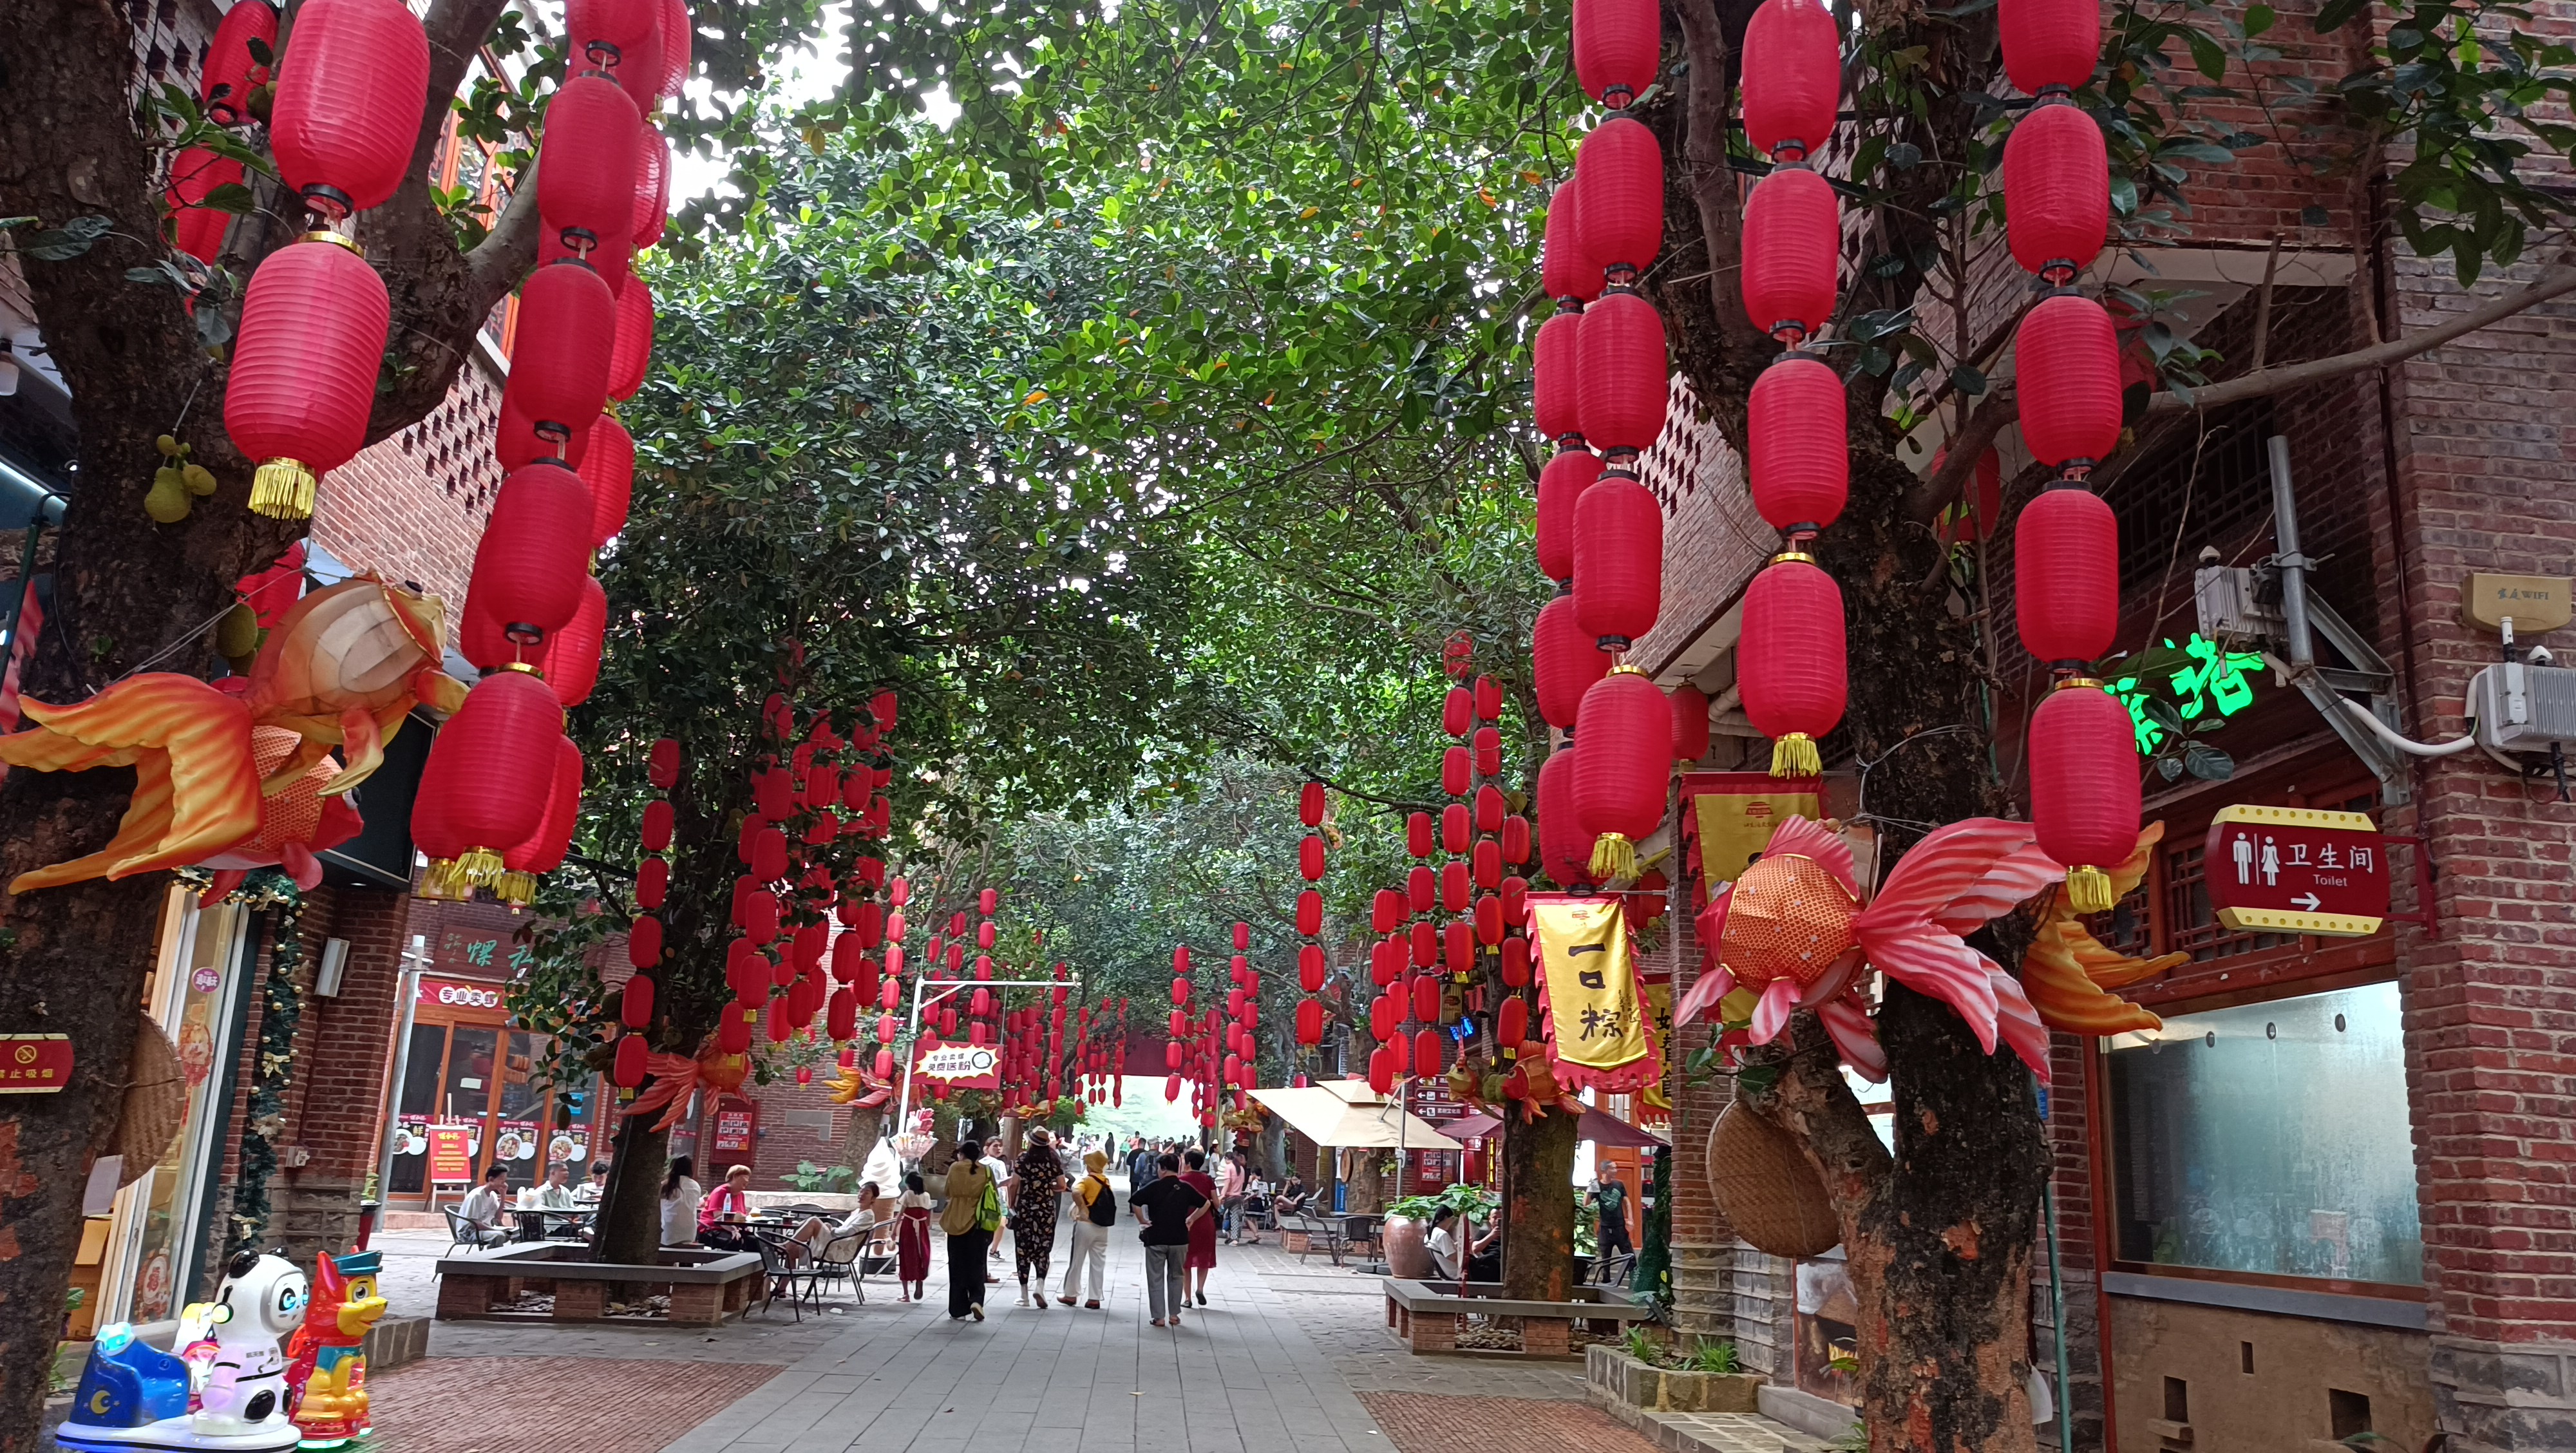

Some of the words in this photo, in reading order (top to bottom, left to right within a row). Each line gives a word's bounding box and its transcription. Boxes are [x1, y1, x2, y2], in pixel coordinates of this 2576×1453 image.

[2285, 842, 2373, 873] 卫生间
[2313, 874, 2348, 887] Toilet
[1568, 942, 1624, 1041] 一口粽
[927, 1061, 971, 1071] 免费送粉
[522, 1132, 532, 1142] 美
